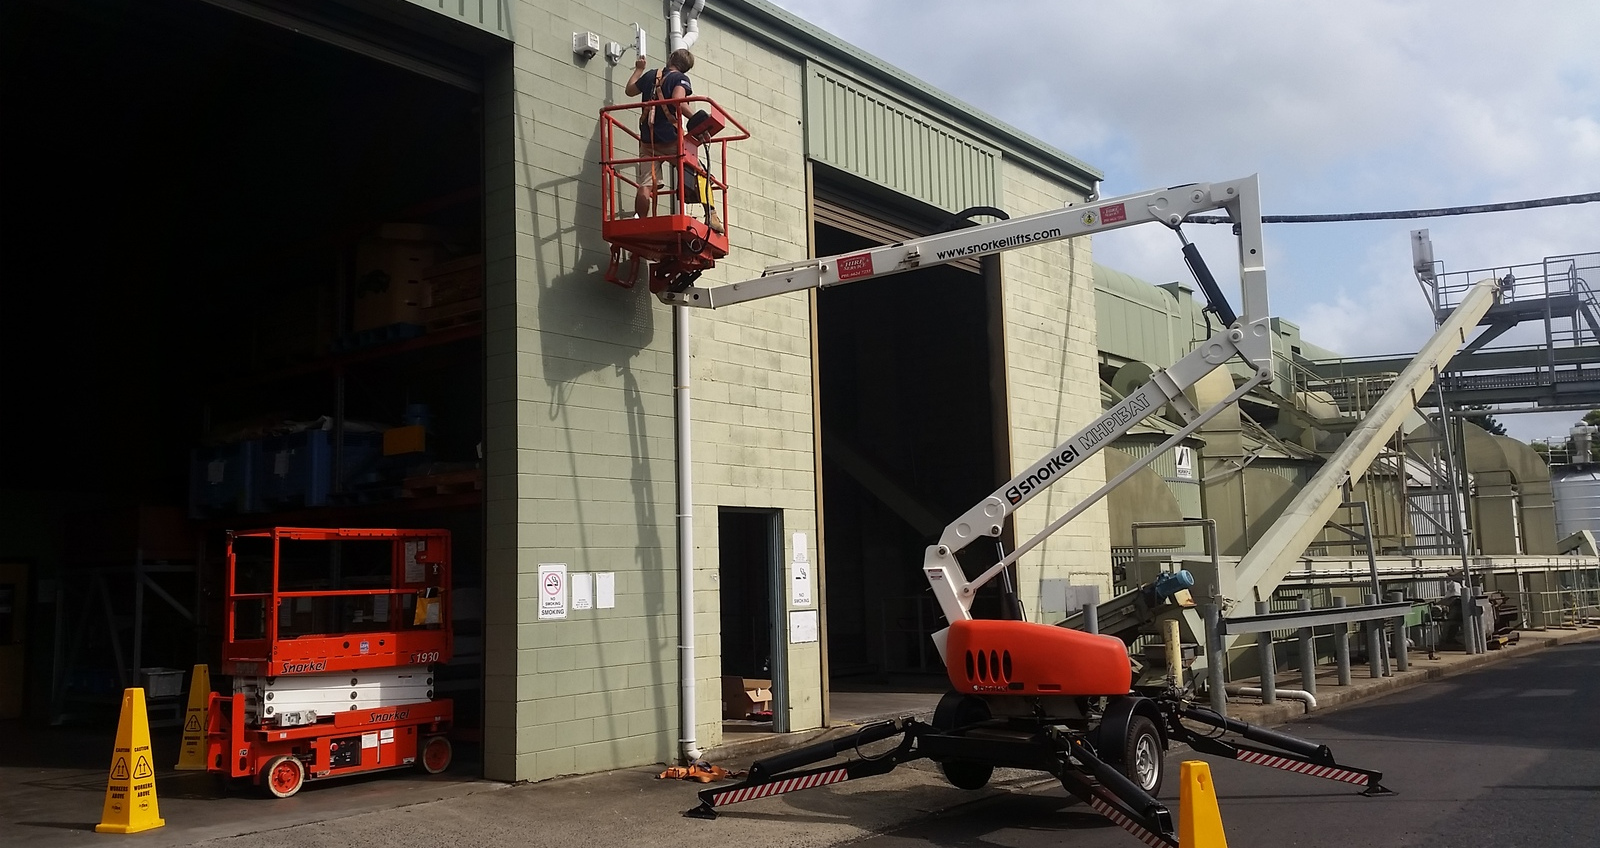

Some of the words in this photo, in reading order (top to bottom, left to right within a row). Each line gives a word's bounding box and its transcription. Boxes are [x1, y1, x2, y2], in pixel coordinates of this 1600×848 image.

[936, 227, 1061, 260] www.snorkellifts.com
[844, 259, 864, 267] HIRE
[1019, 444, 1080, 496] snorkel
[281, 660, 327, 674] Snorkel
[369, 709, 410, 723] Snorkel
[133, 782, 153, 791] WORKERS
[137, 790, 150, 798] ABOVE
